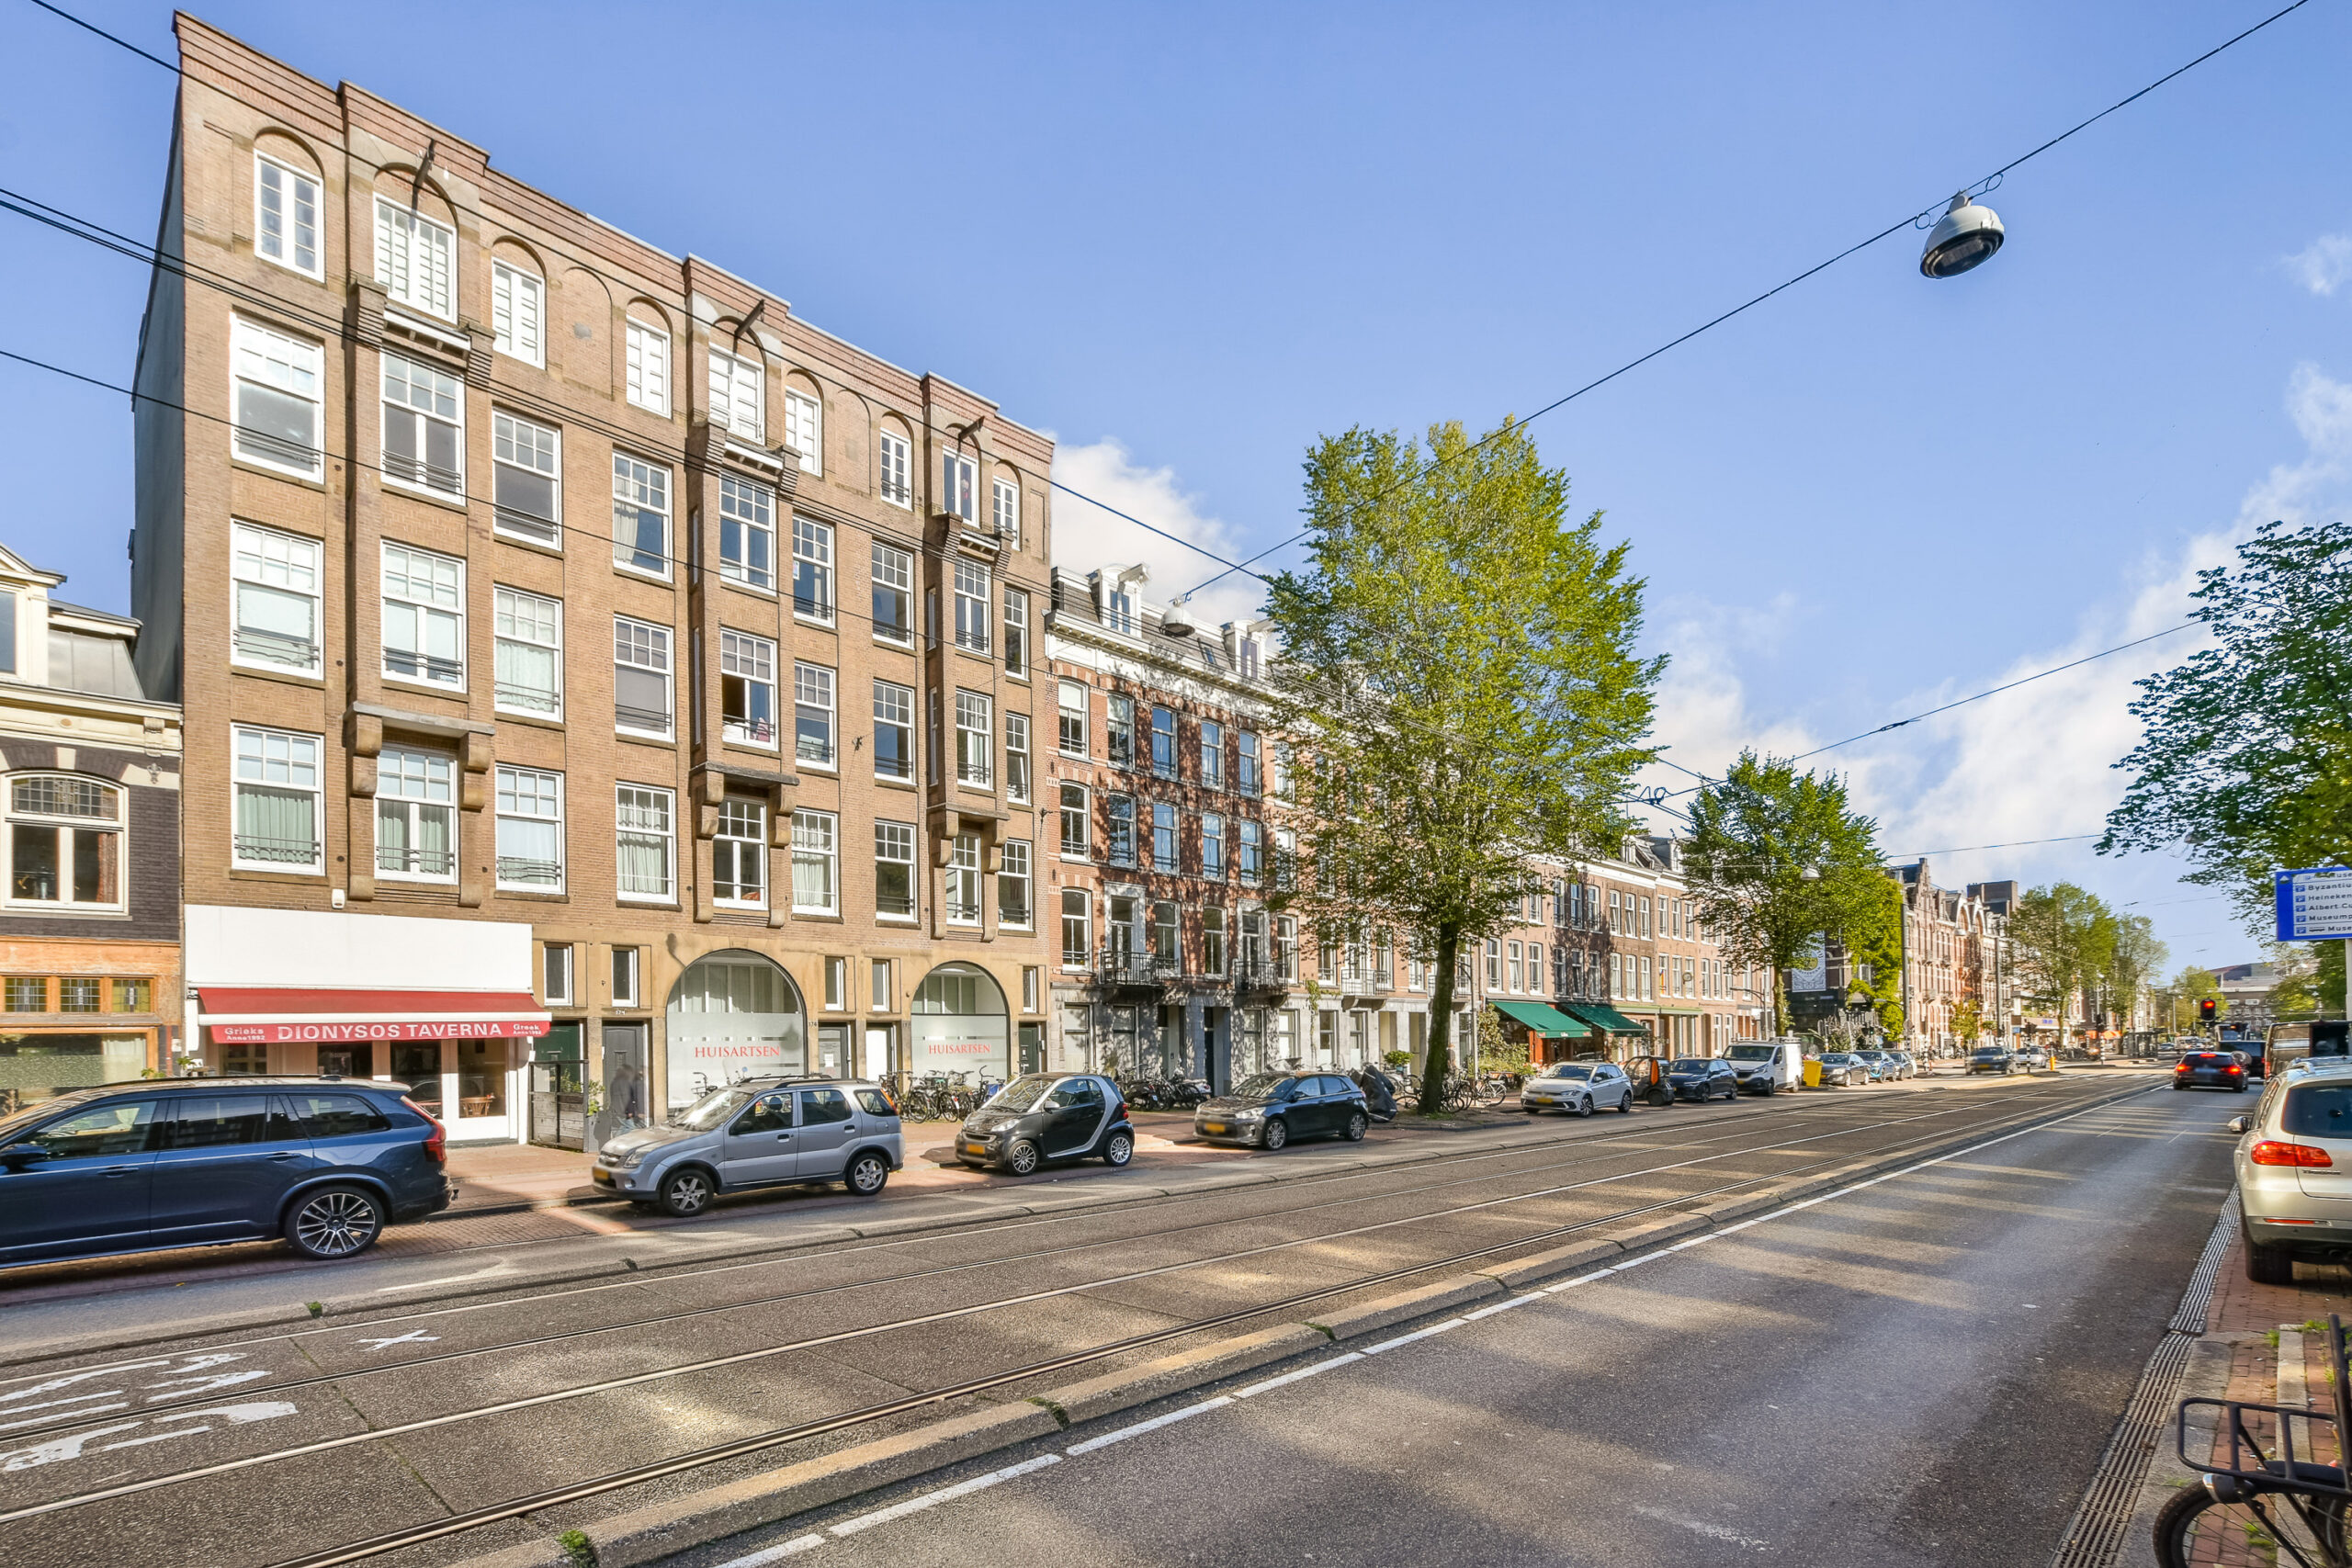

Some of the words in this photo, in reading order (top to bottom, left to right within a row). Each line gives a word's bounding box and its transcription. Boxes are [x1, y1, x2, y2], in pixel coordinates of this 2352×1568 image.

[277, 1024, 401, 1040] DIONYSOS
[406, 1023, 503, 1037] TAVERNA
[695, 1045, 780, 1057] HUISARTSEN
[928, 1043, 991, 1055] HUISARTSEN
